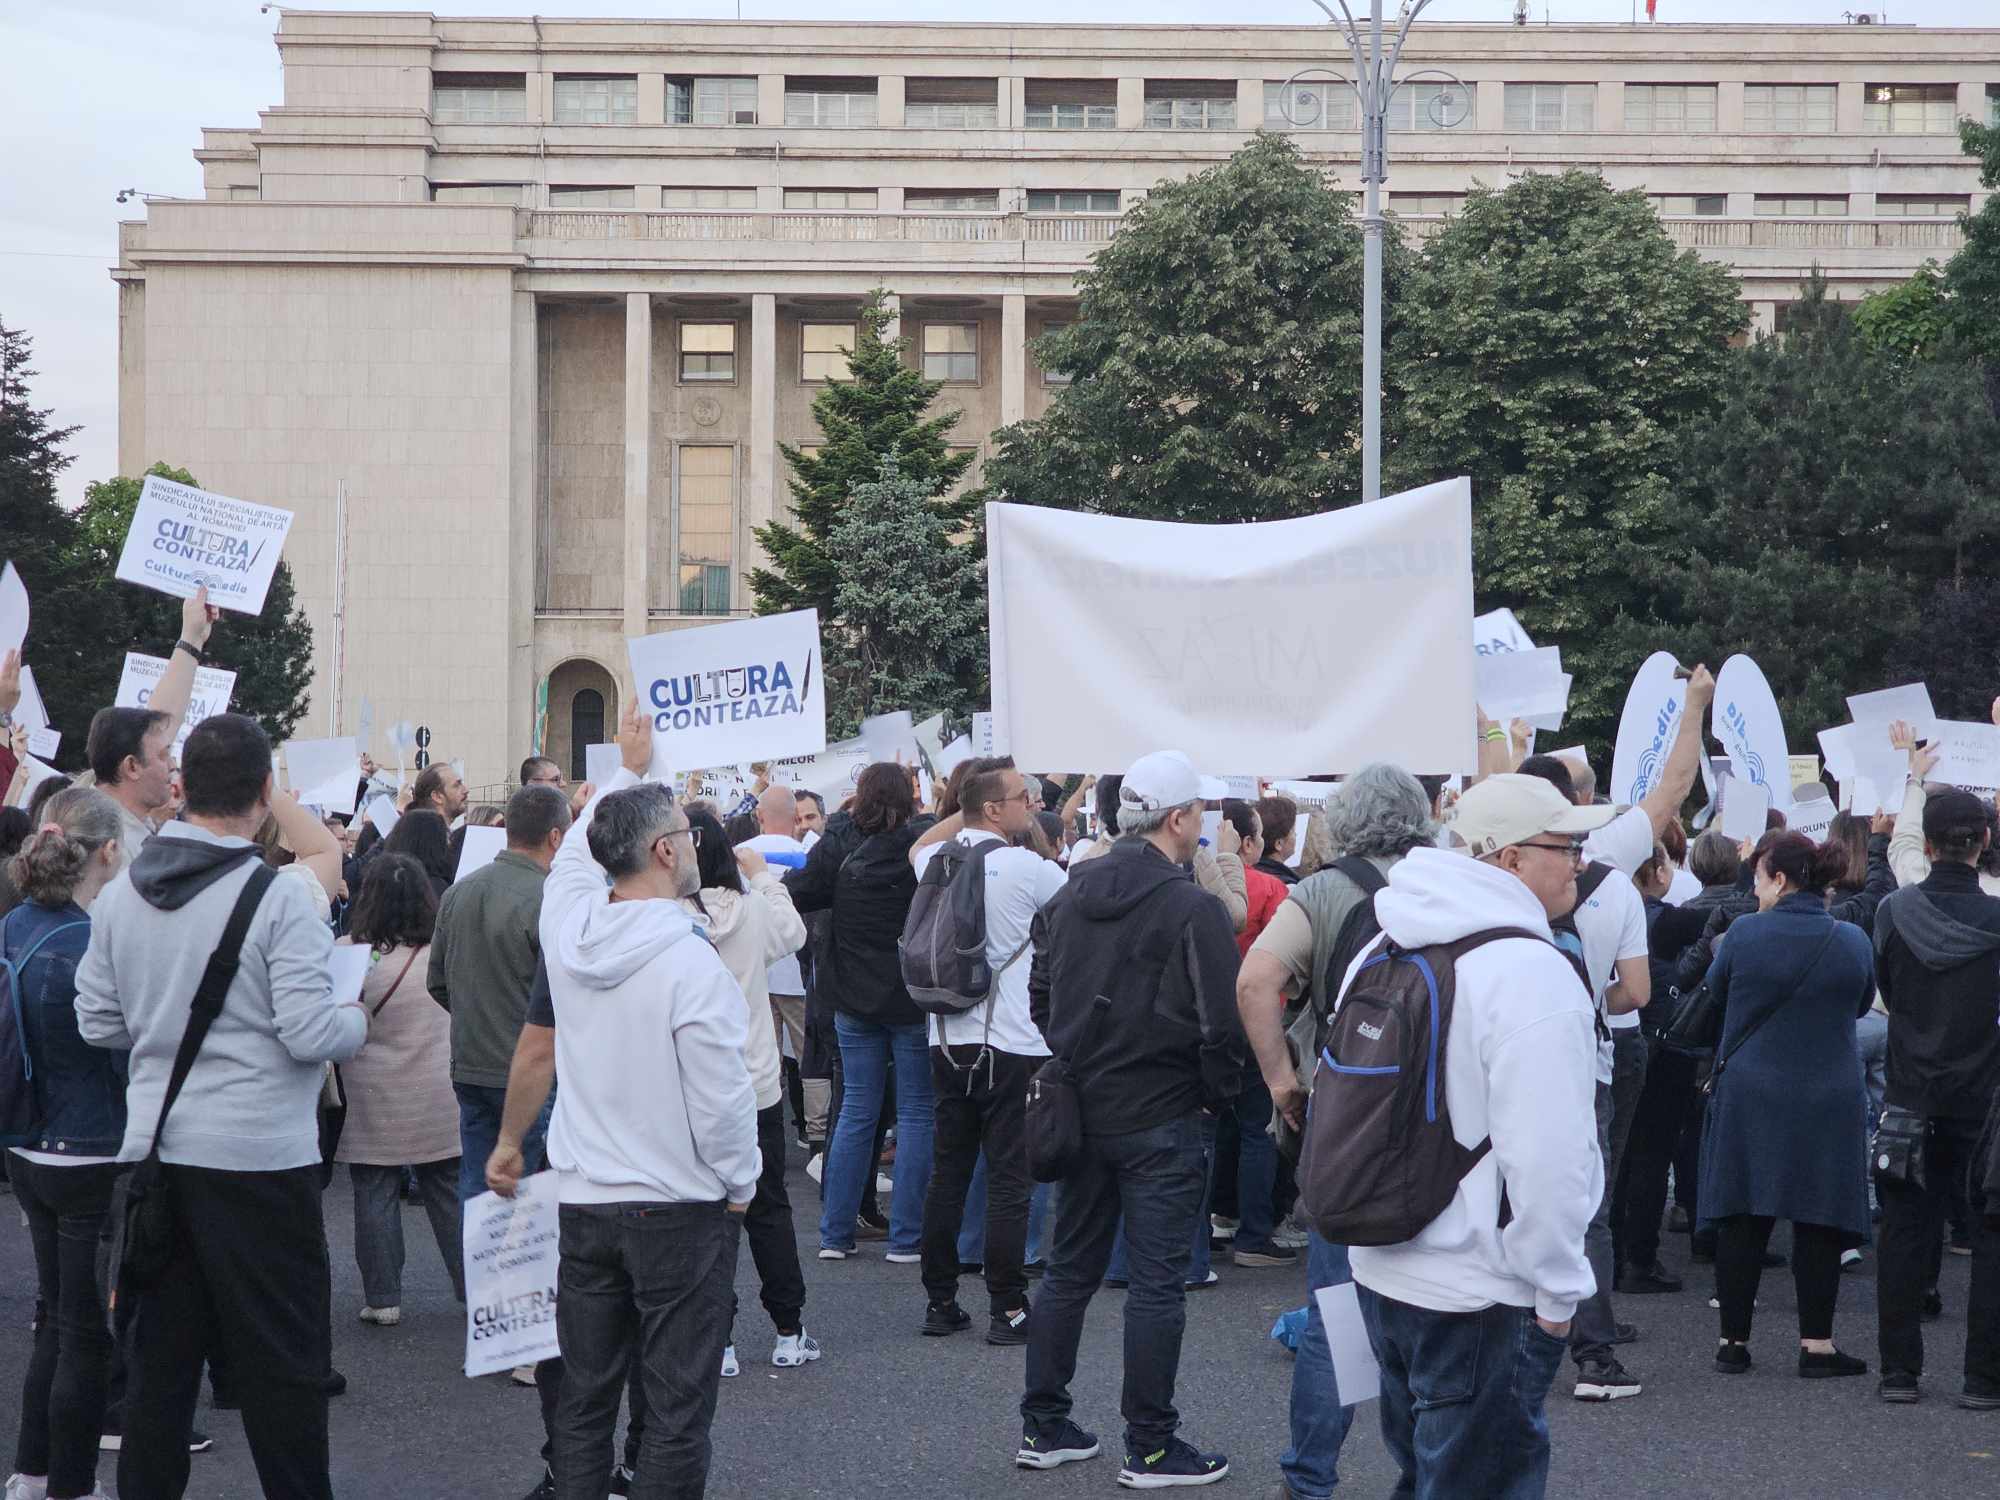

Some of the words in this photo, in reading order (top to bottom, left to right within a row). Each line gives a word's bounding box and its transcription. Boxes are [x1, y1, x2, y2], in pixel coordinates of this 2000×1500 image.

[150, 491, 198, 510] MUZEULUI
[247, 517, 258, 527] DE
[152, 482, 216, 506] SINDICATULUI
[186, 512, 199, 521] AL
[158, 519, 249, 558] CULTURA
[649, 661, 793, 709] CULTURA
